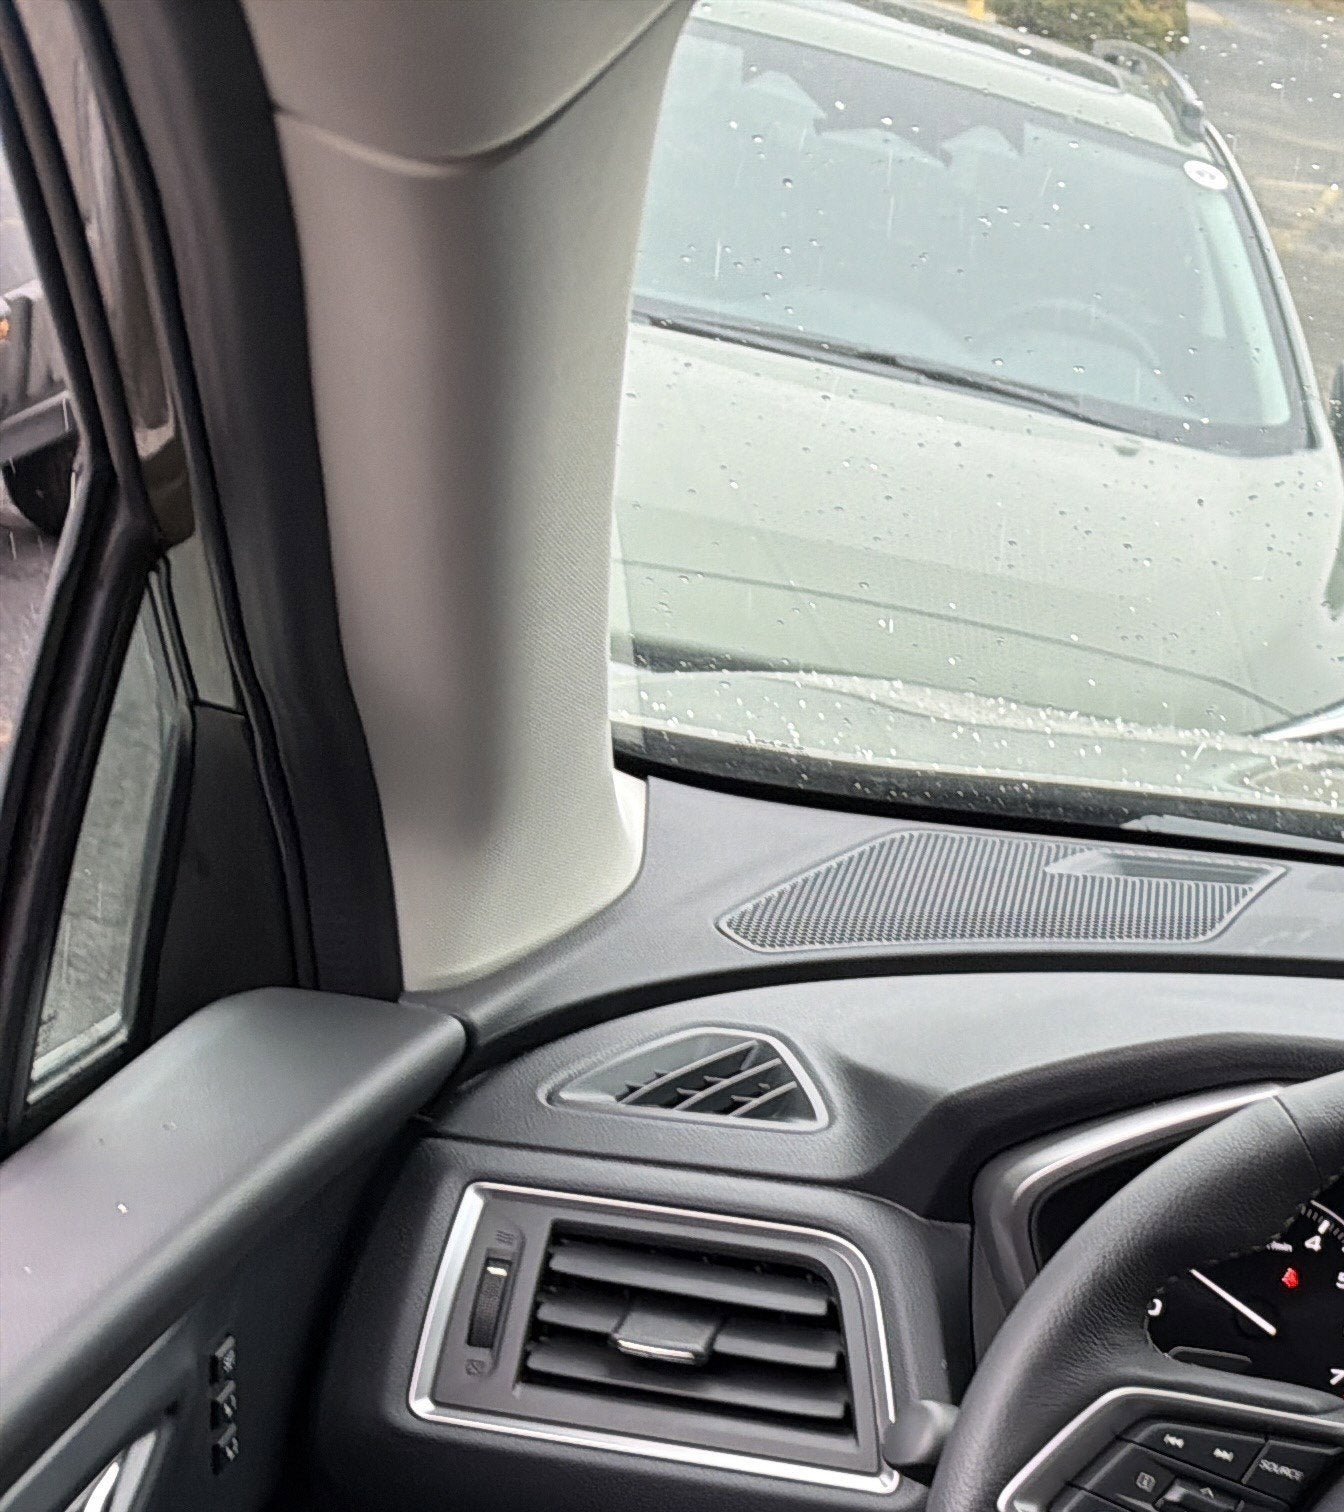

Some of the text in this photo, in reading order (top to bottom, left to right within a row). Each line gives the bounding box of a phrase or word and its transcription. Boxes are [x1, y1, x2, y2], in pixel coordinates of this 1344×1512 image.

[1304, 1235, 1322, 1252] 4
[1330, 1369, 1344, 1386] 7
[1258, 1458, 1304, 1482] SOURCE
